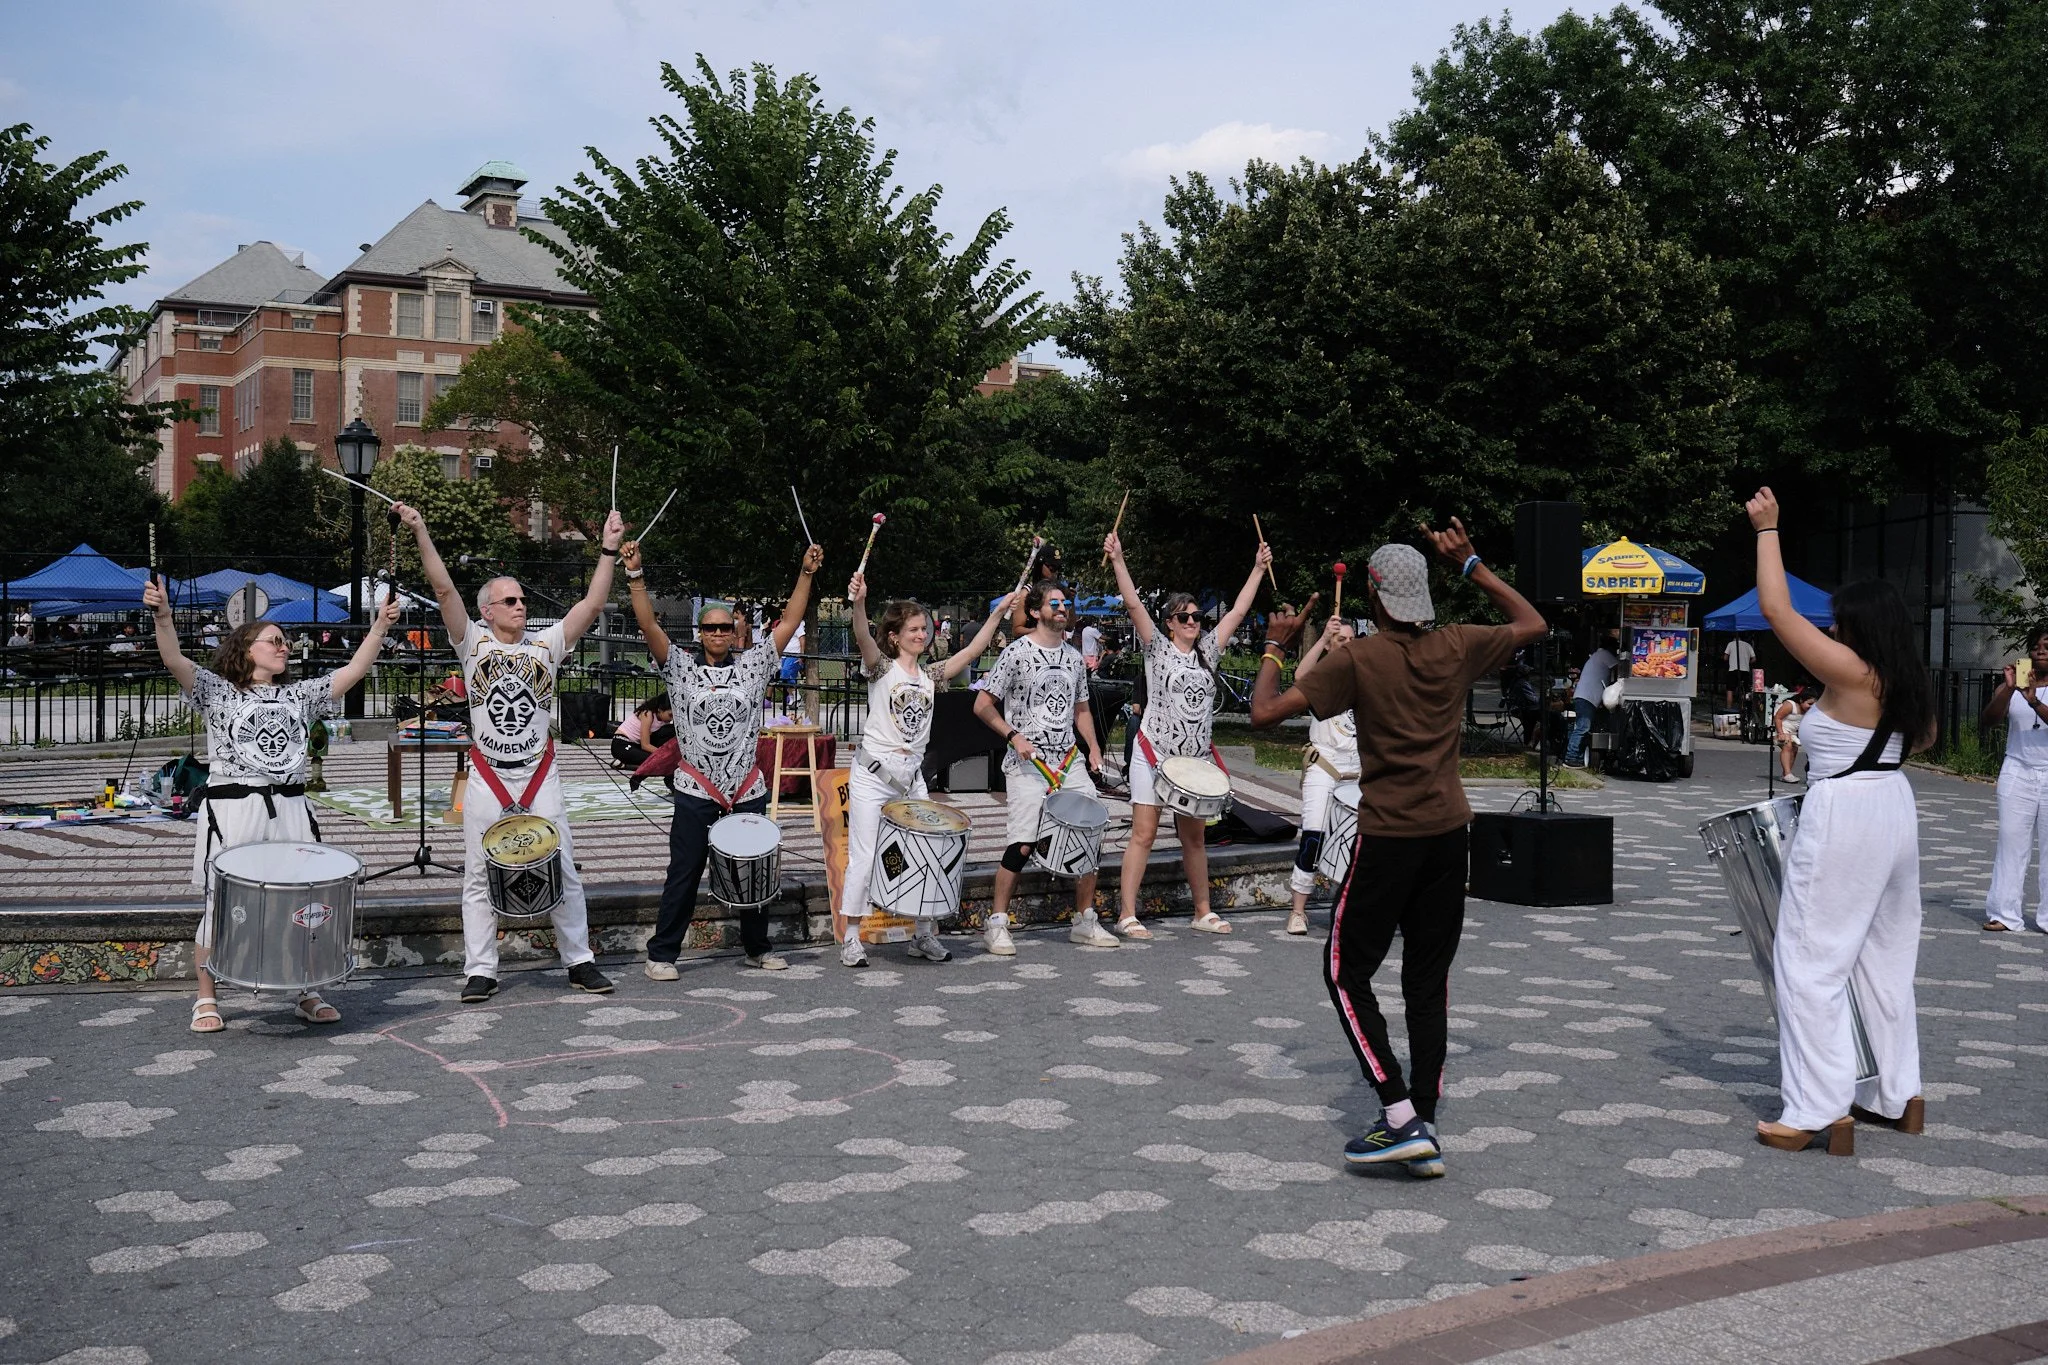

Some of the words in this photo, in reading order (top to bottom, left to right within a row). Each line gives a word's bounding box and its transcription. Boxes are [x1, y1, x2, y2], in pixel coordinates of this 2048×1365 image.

[1597, 554, 1645, 564] SABRETT
[1586, 577, 1659, 588] SABRETT
[480, 729, 541, 754] MAMBEMBÉ
